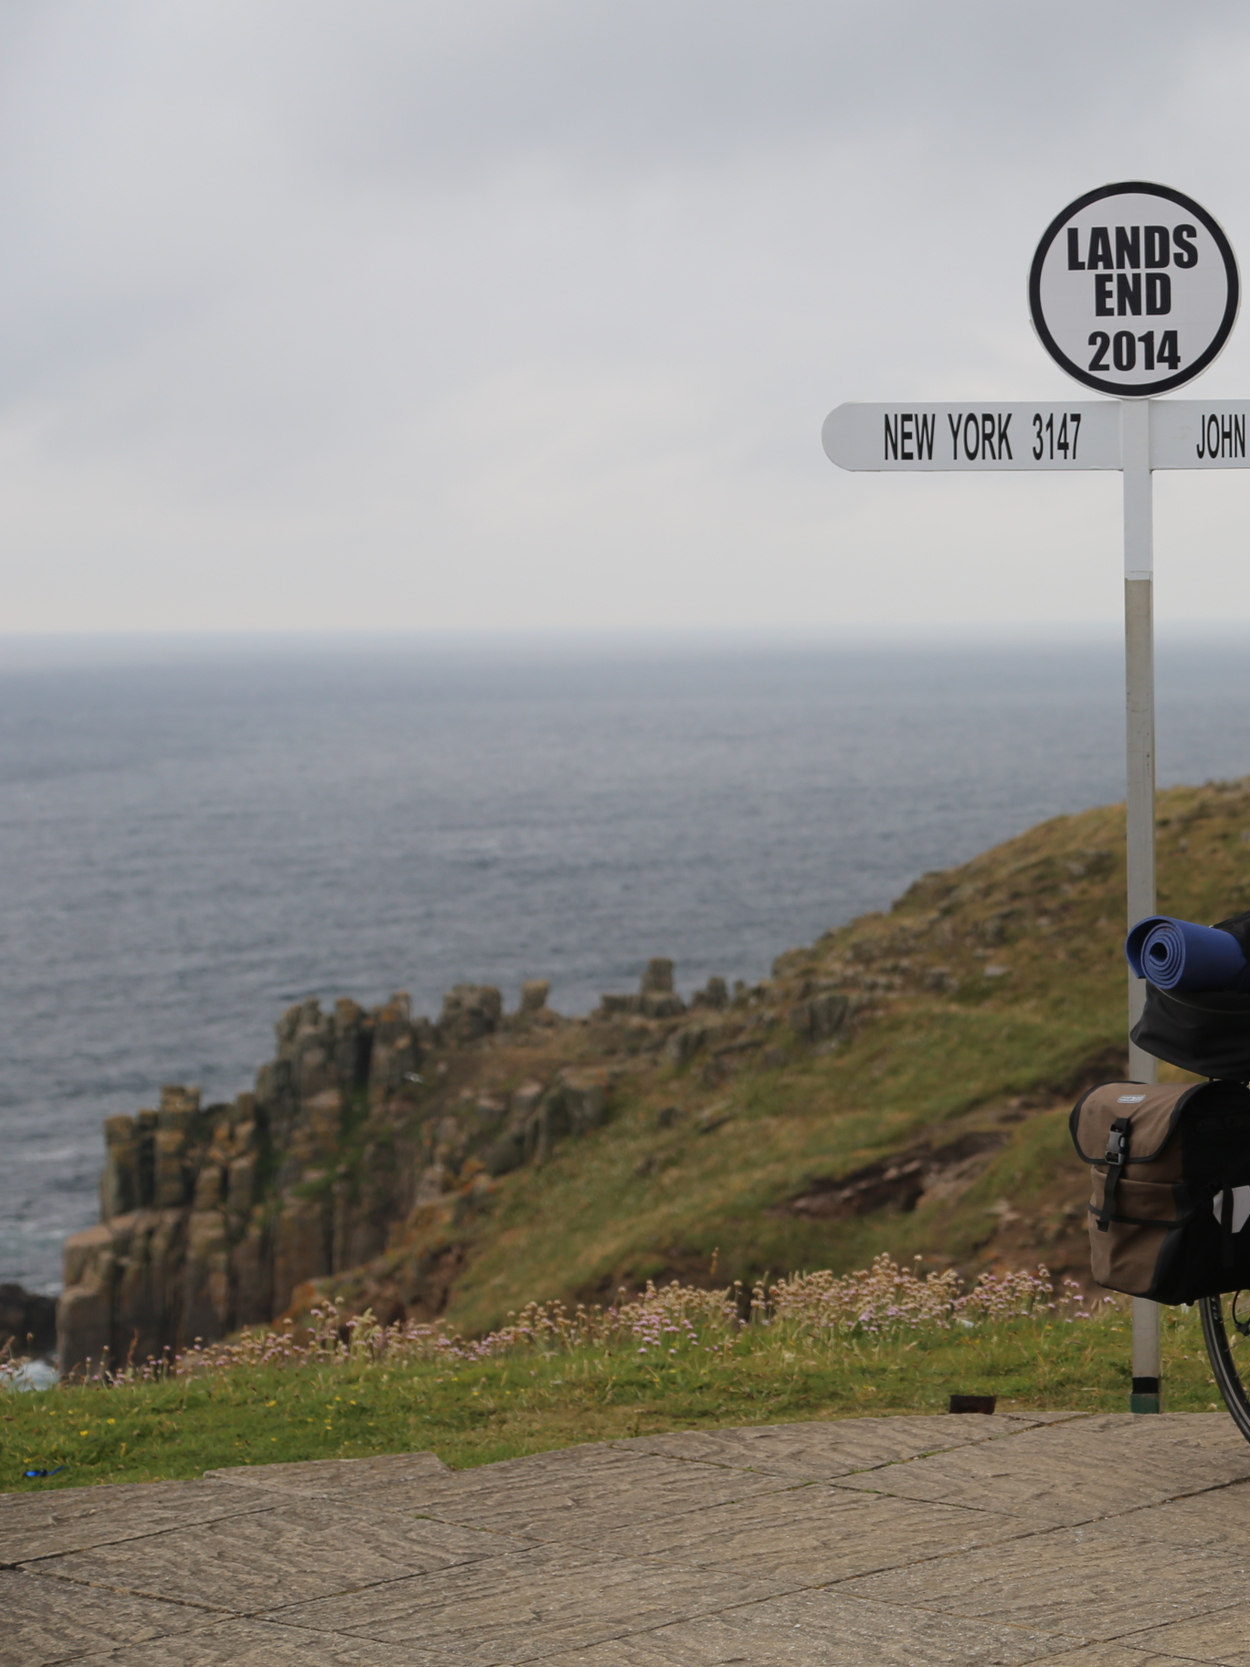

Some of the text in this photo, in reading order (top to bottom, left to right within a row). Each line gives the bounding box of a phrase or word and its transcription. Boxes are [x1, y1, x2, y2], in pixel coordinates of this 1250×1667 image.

[1067, 224, 1199, 271] LANDS
[1095, 273, 1172, 317] END
[1087, 330, 1182, 372] 2014
[884, 412, 1082, 461] NEW YORK 3147
[1196, 413, 1246, 460] JOHN
